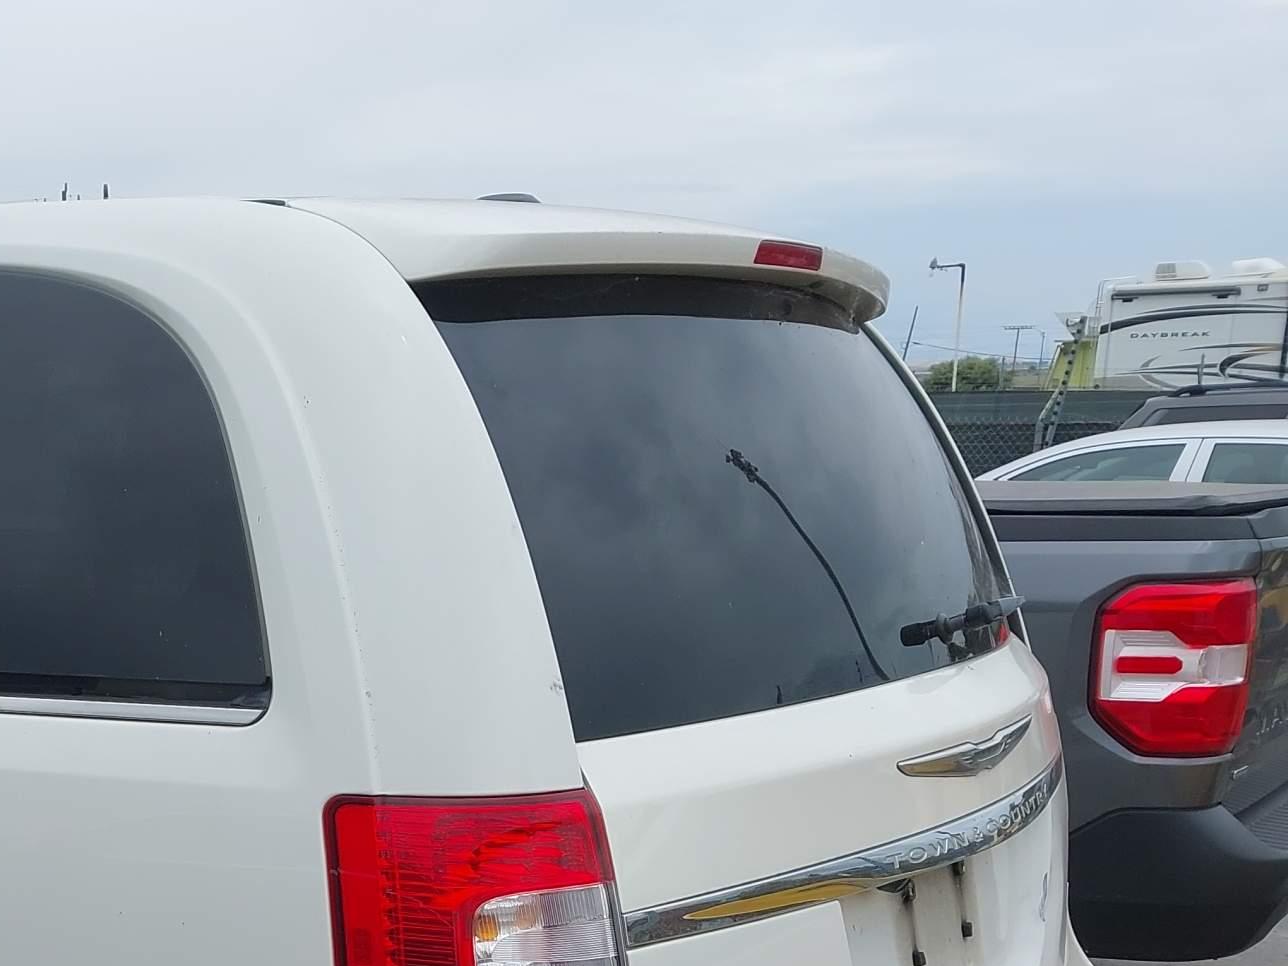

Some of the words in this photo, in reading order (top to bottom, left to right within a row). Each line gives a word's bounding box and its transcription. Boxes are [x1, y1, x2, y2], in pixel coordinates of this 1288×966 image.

[1129, 331, 1211, 339] DAYBREAK
[885, 830, 970, 870] TOWN
[973, 826, 985, 843] &
